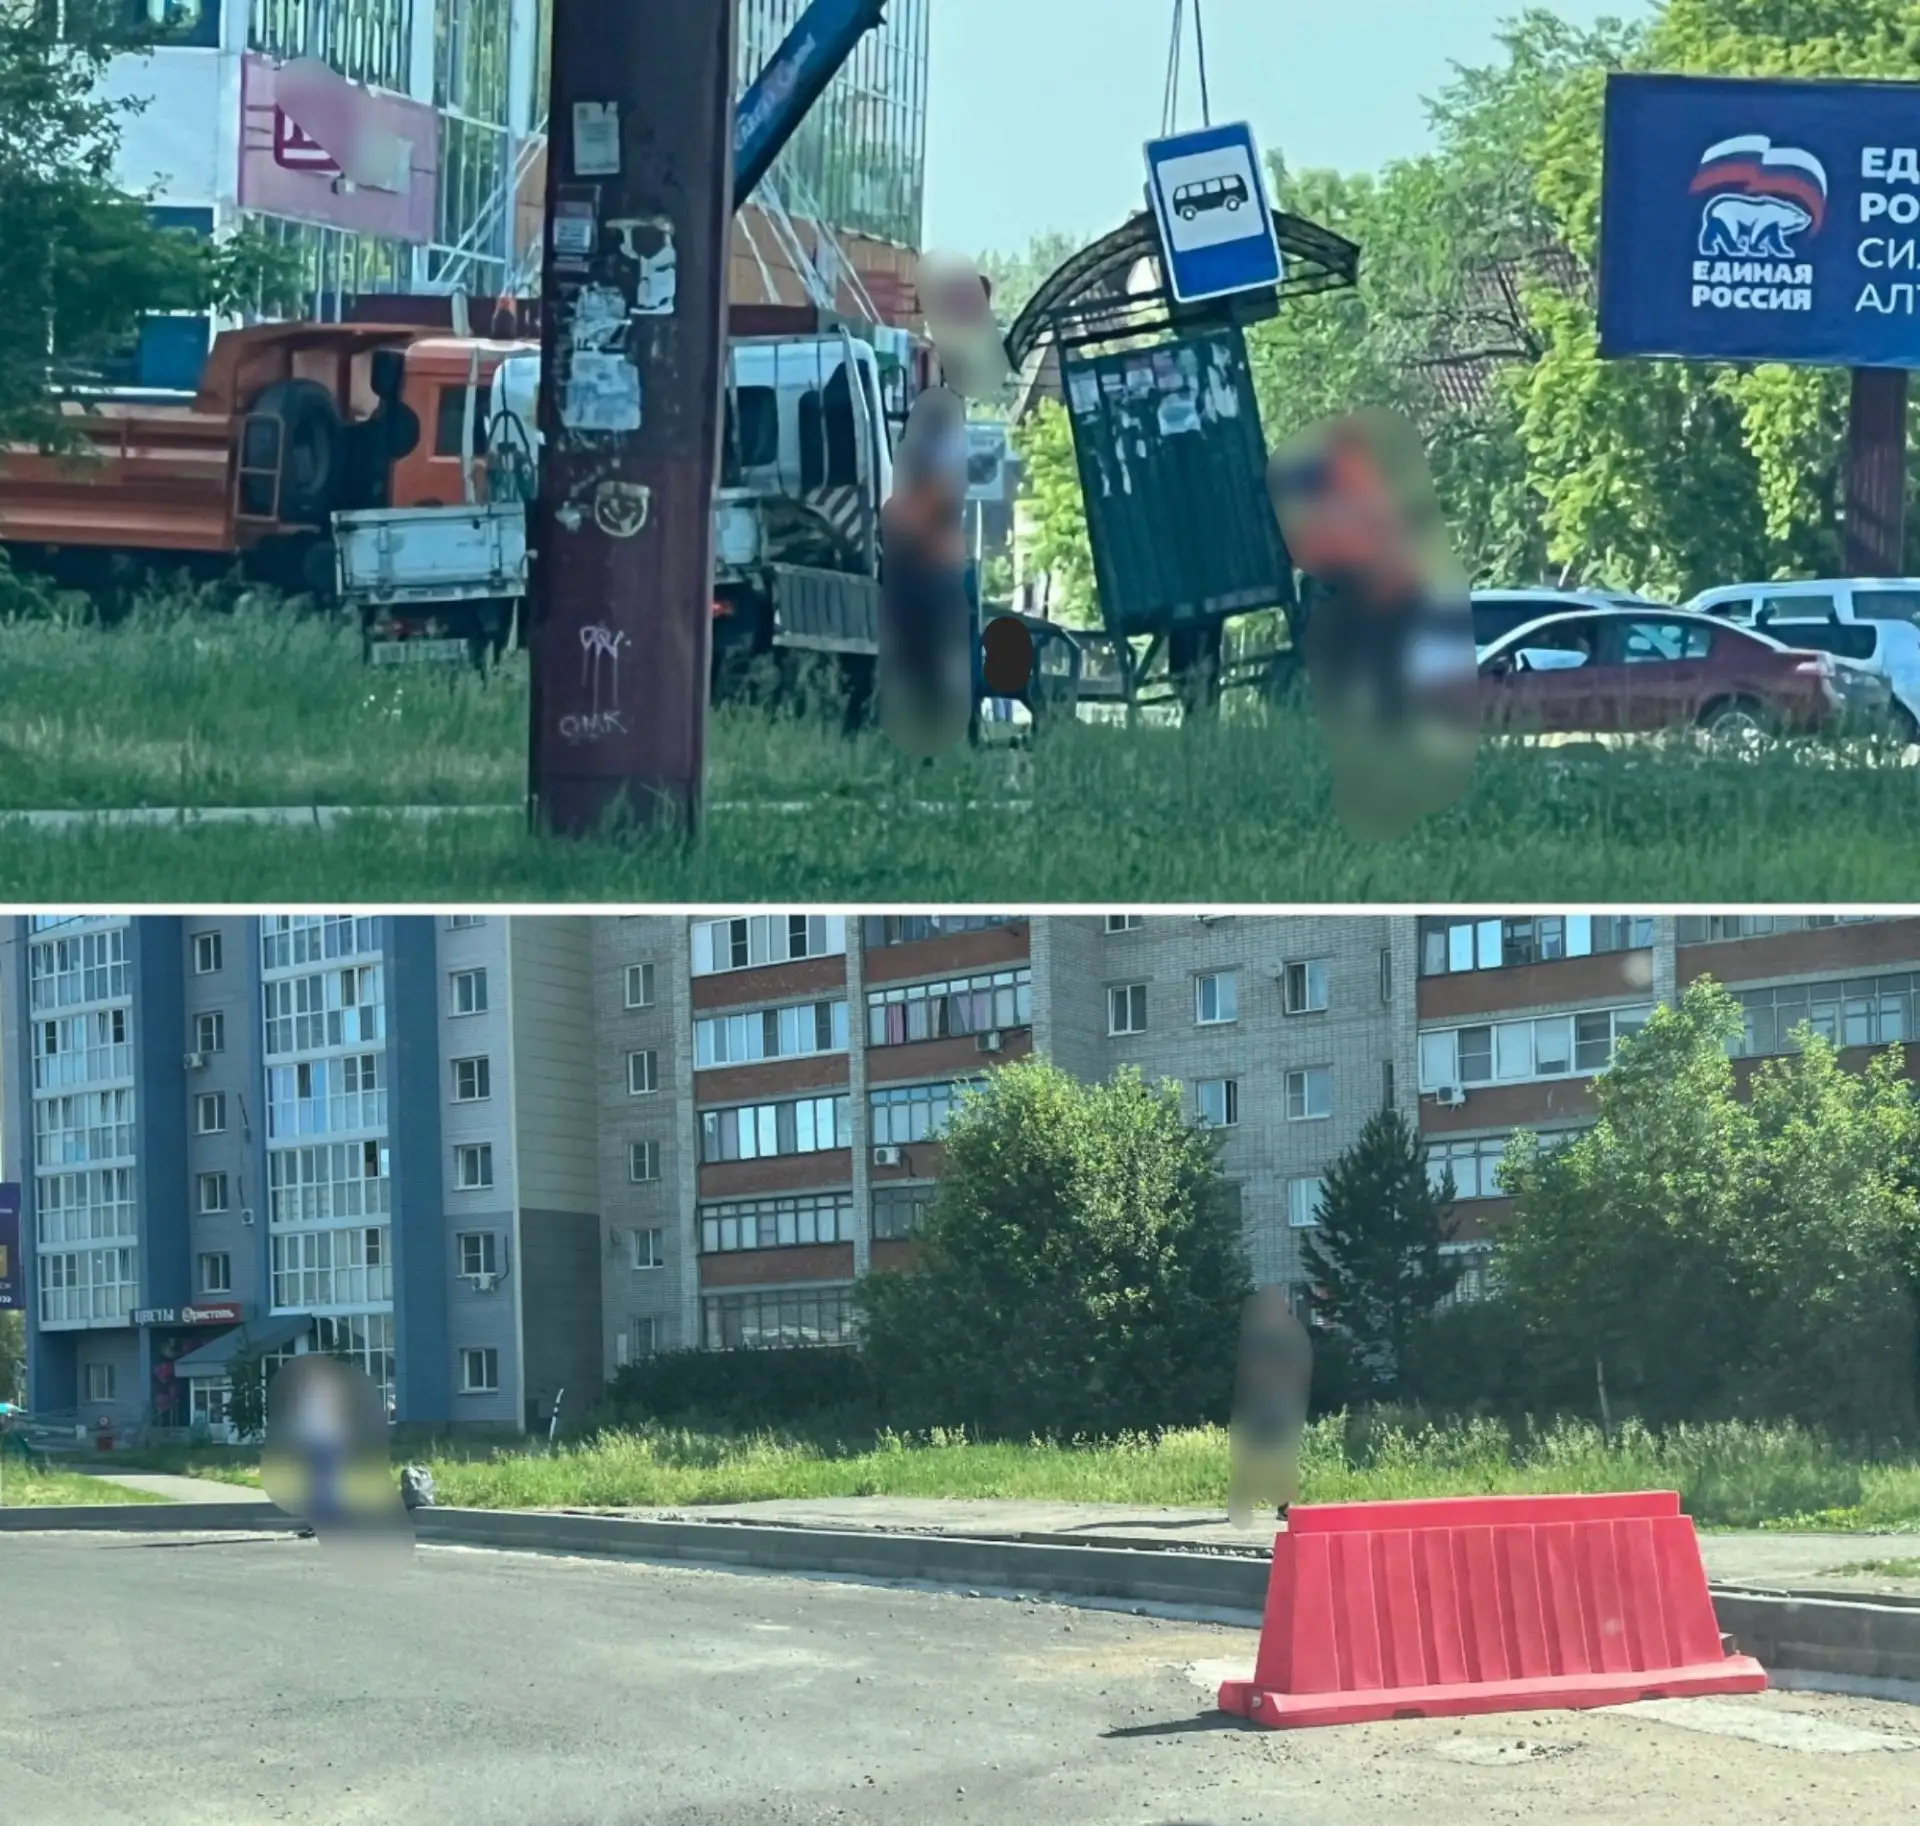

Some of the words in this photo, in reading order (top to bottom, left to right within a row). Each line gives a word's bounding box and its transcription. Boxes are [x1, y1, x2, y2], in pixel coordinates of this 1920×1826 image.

[1857, 237, 1920, 270] СИ
[1692, 260, 1813, 285] ЕДИНАЯ
[1691, 285, 1812, 311] РОССИЯ
[135, 1308, 174, 1325] ЦВЕТЫ
